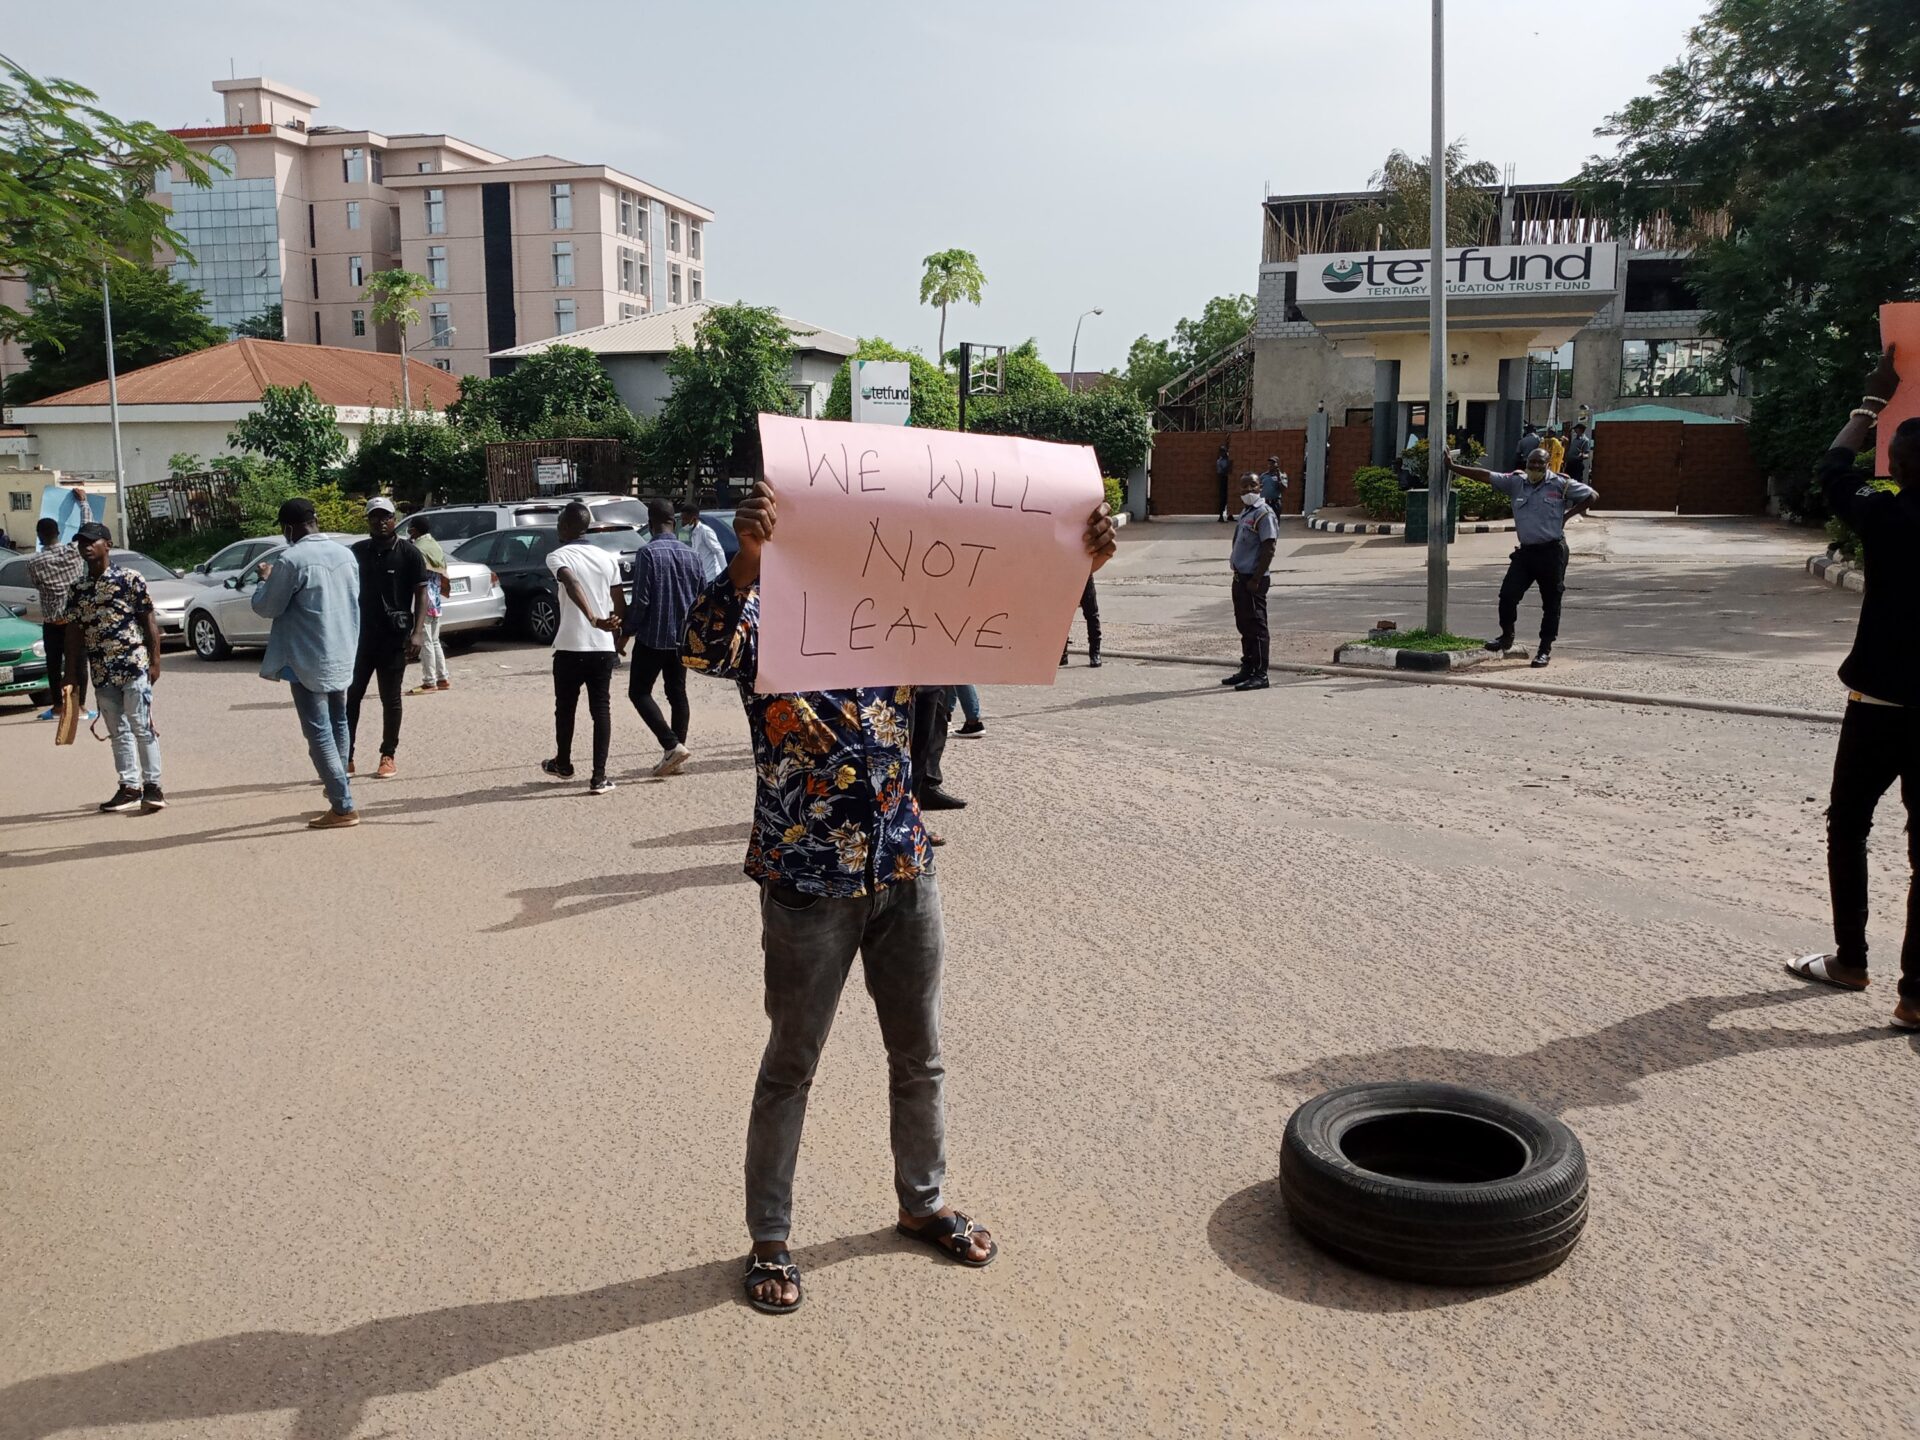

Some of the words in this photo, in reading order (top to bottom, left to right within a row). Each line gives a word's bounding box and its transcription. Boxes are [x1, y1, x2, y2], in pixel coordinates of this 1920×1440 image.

[1366, 246, 1592, 287] tefund
[1367, 286, 1428, 296] TERTIARY
[1445, 283, 1504, 294] UCATION
[1509, 282, 1551, 292] TRUST
[1554, 281, 1591, 291] FUND
[871, 385, 909, 401] tetfund
[800, 426, 886, 495] WE
[926, 444, 1052, 515] WILL
[862, 517, 996, 588] NOT
